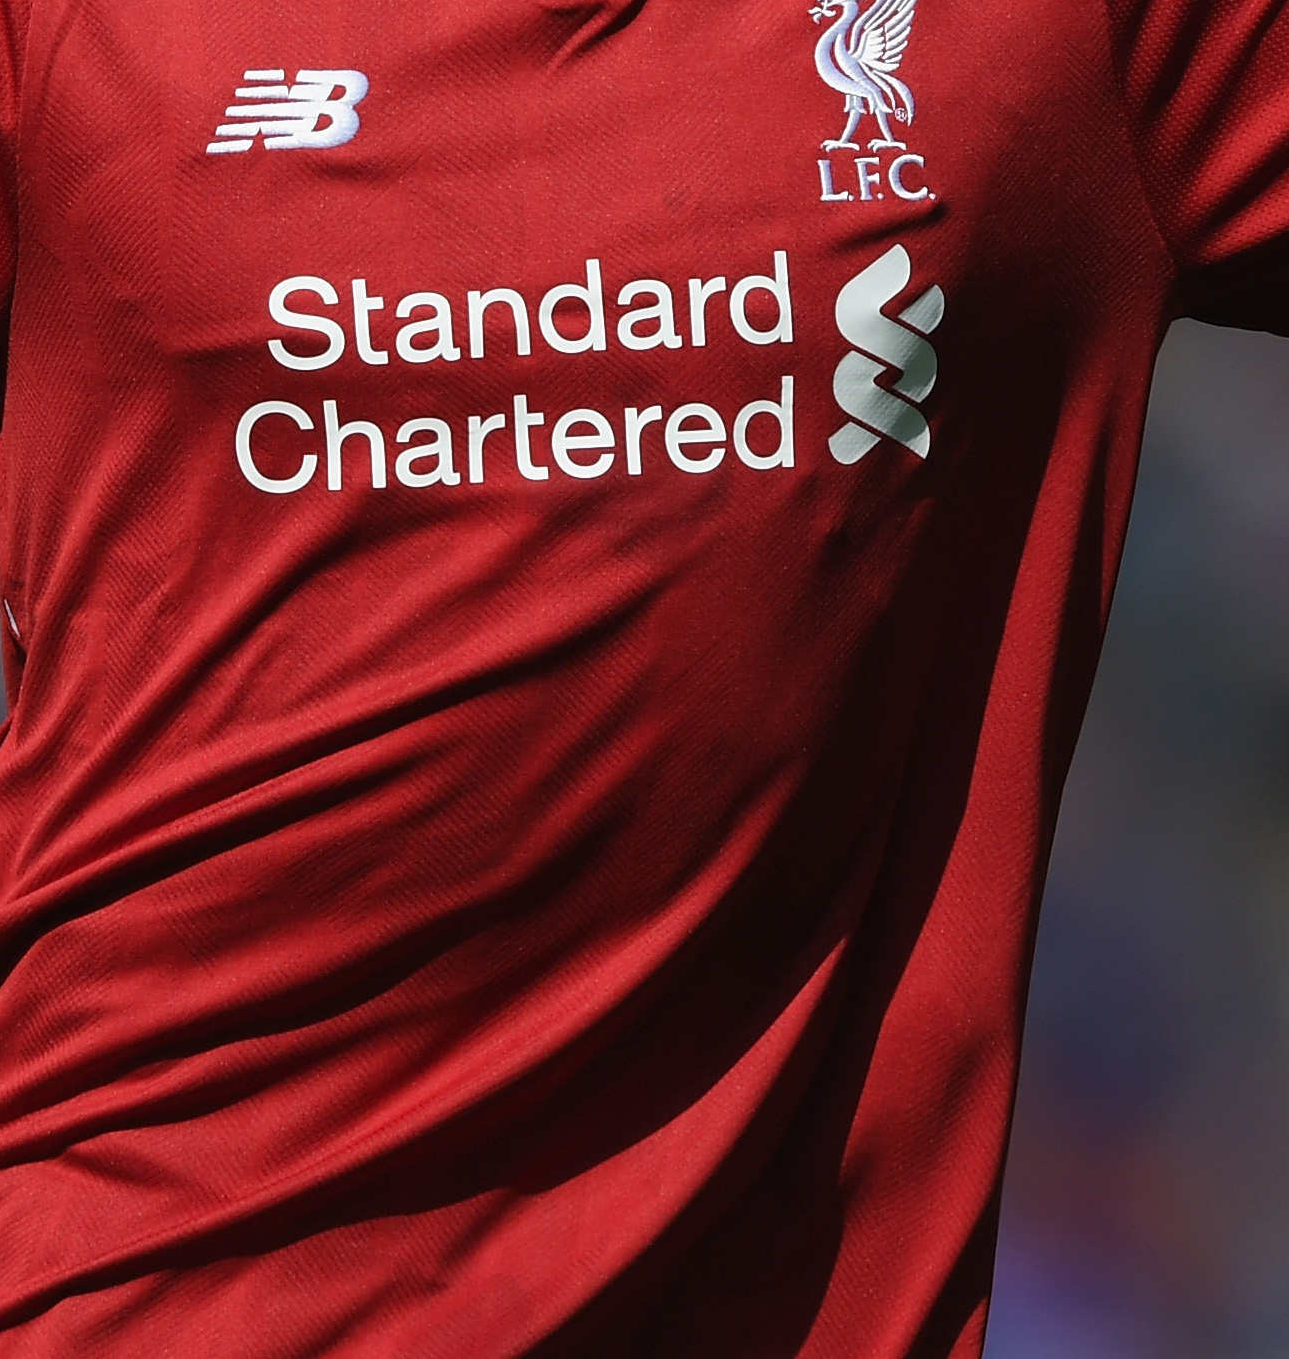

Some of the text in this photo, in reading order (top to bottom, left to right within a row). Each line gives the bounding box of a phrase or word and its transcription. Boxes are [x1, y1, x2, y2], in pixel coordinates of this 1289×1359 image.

[205, 68, 370, 155] NB
[816, 153, 937, 203] L.F.C.
[266, 249, 795, 372] Standard
[234, 374, 796, 495] Chartered
